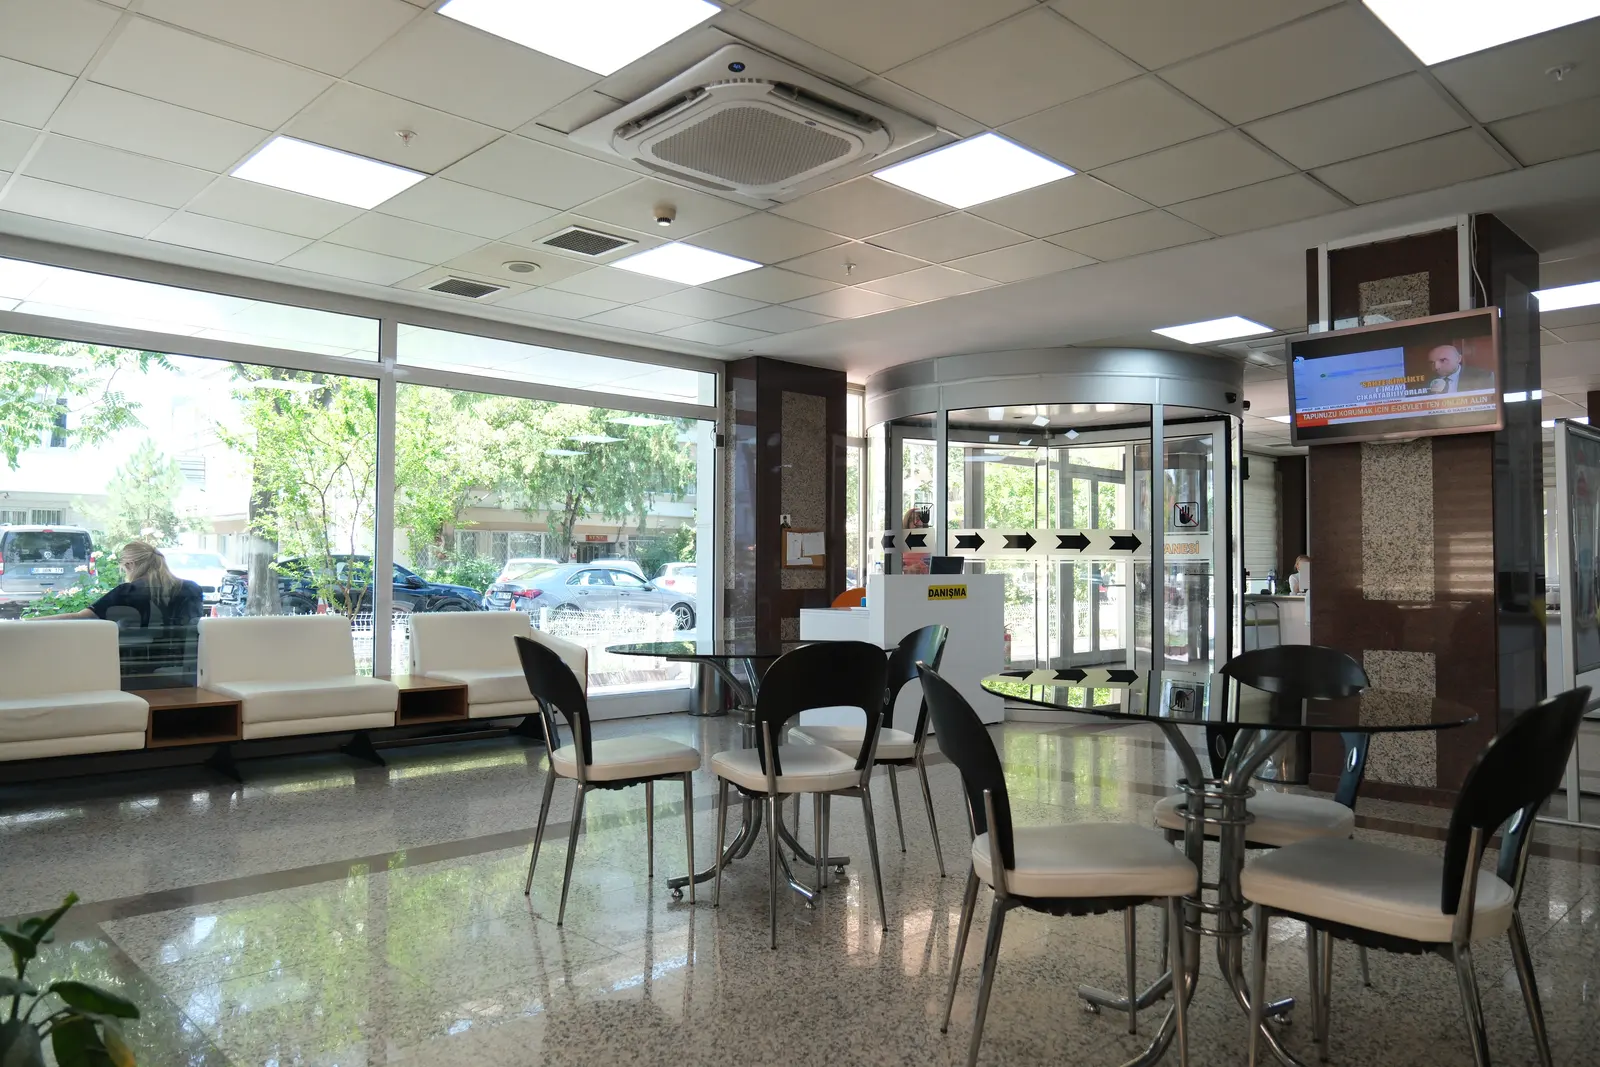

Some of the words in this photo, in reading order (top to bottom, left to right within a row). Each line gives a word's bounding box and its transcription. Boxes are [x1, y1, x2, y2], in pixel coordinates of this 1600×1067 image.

[1303, 411, 1337, 420] TAPUNUZU
[1339, 407, 1373, 417] KORUMAK
[928, 588, 966, 599] DANIŞMA
